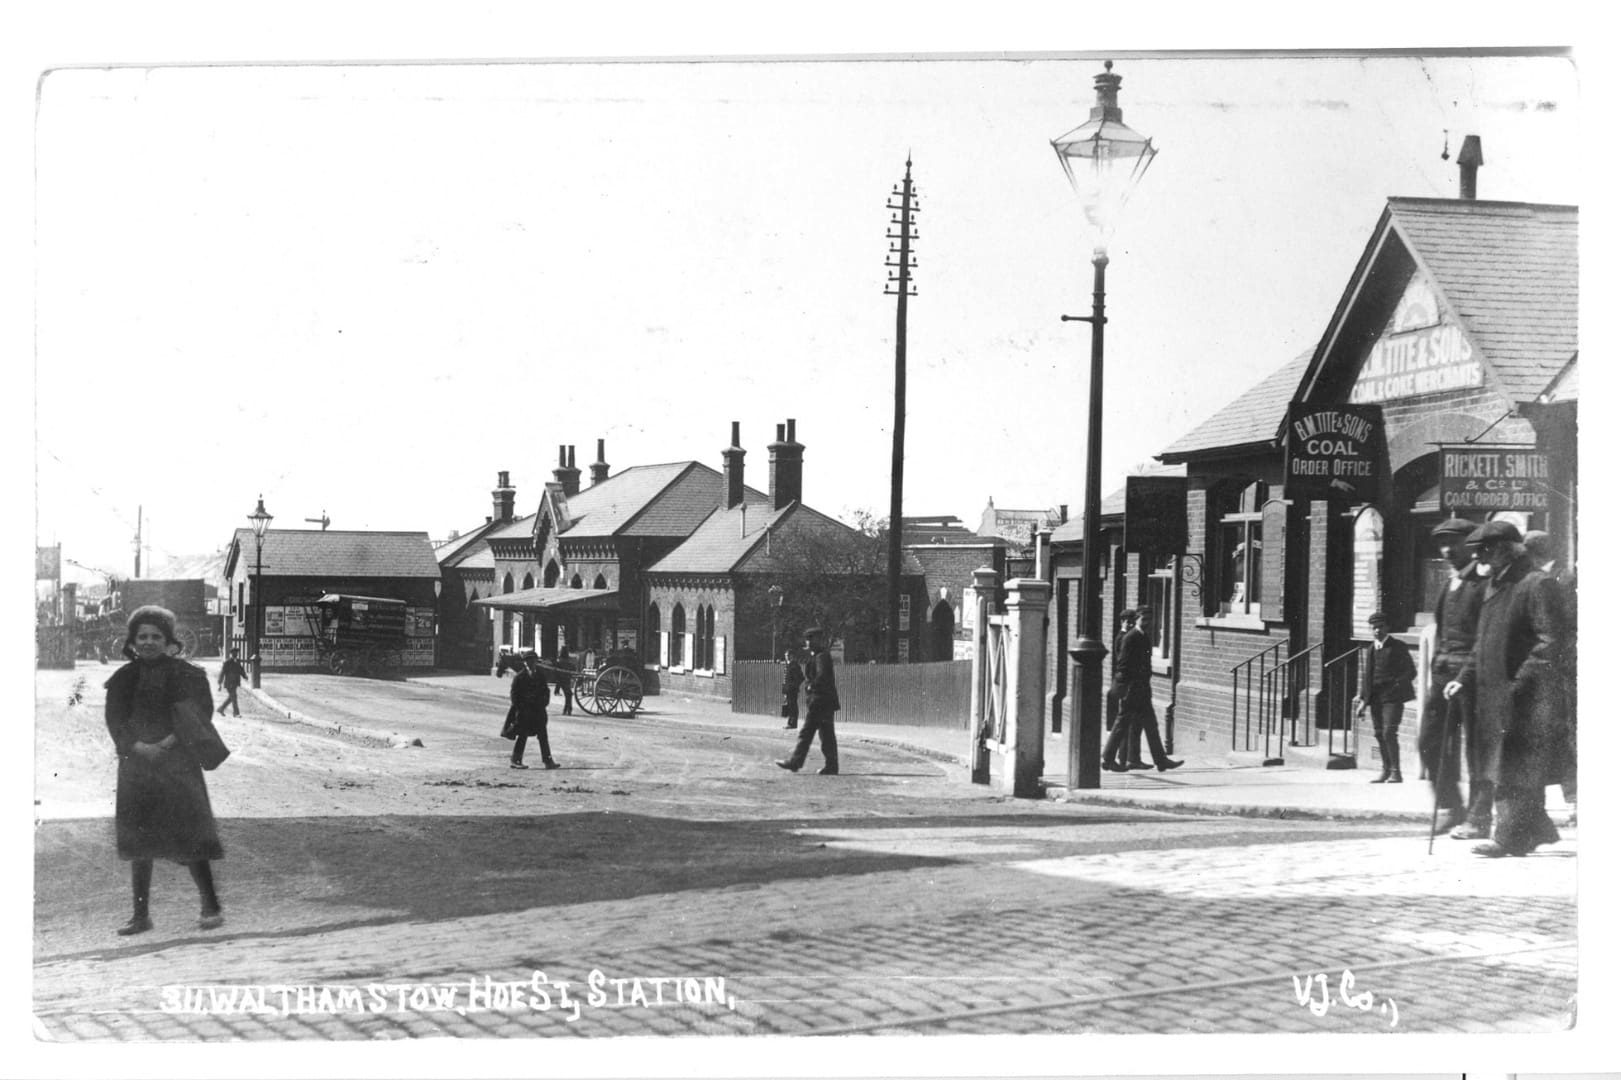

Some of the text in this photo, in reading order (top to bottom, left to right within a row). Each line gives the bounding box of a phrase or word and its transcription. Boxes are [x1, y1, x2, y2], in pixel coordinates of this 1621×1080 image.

[1429, 326, 1473, 366] SONS
[1341, 413, 1373, 443] SONS
[1307, 439, 1359, 455] COAL
[1292, 458, 1373, 476] ORDER OFFICE
[1505, 454, 1549, 478] SMITH
[1465, 480, 1480, 490] &
[1444, 491, 1548, 507] COAL ORDER OFFICE
